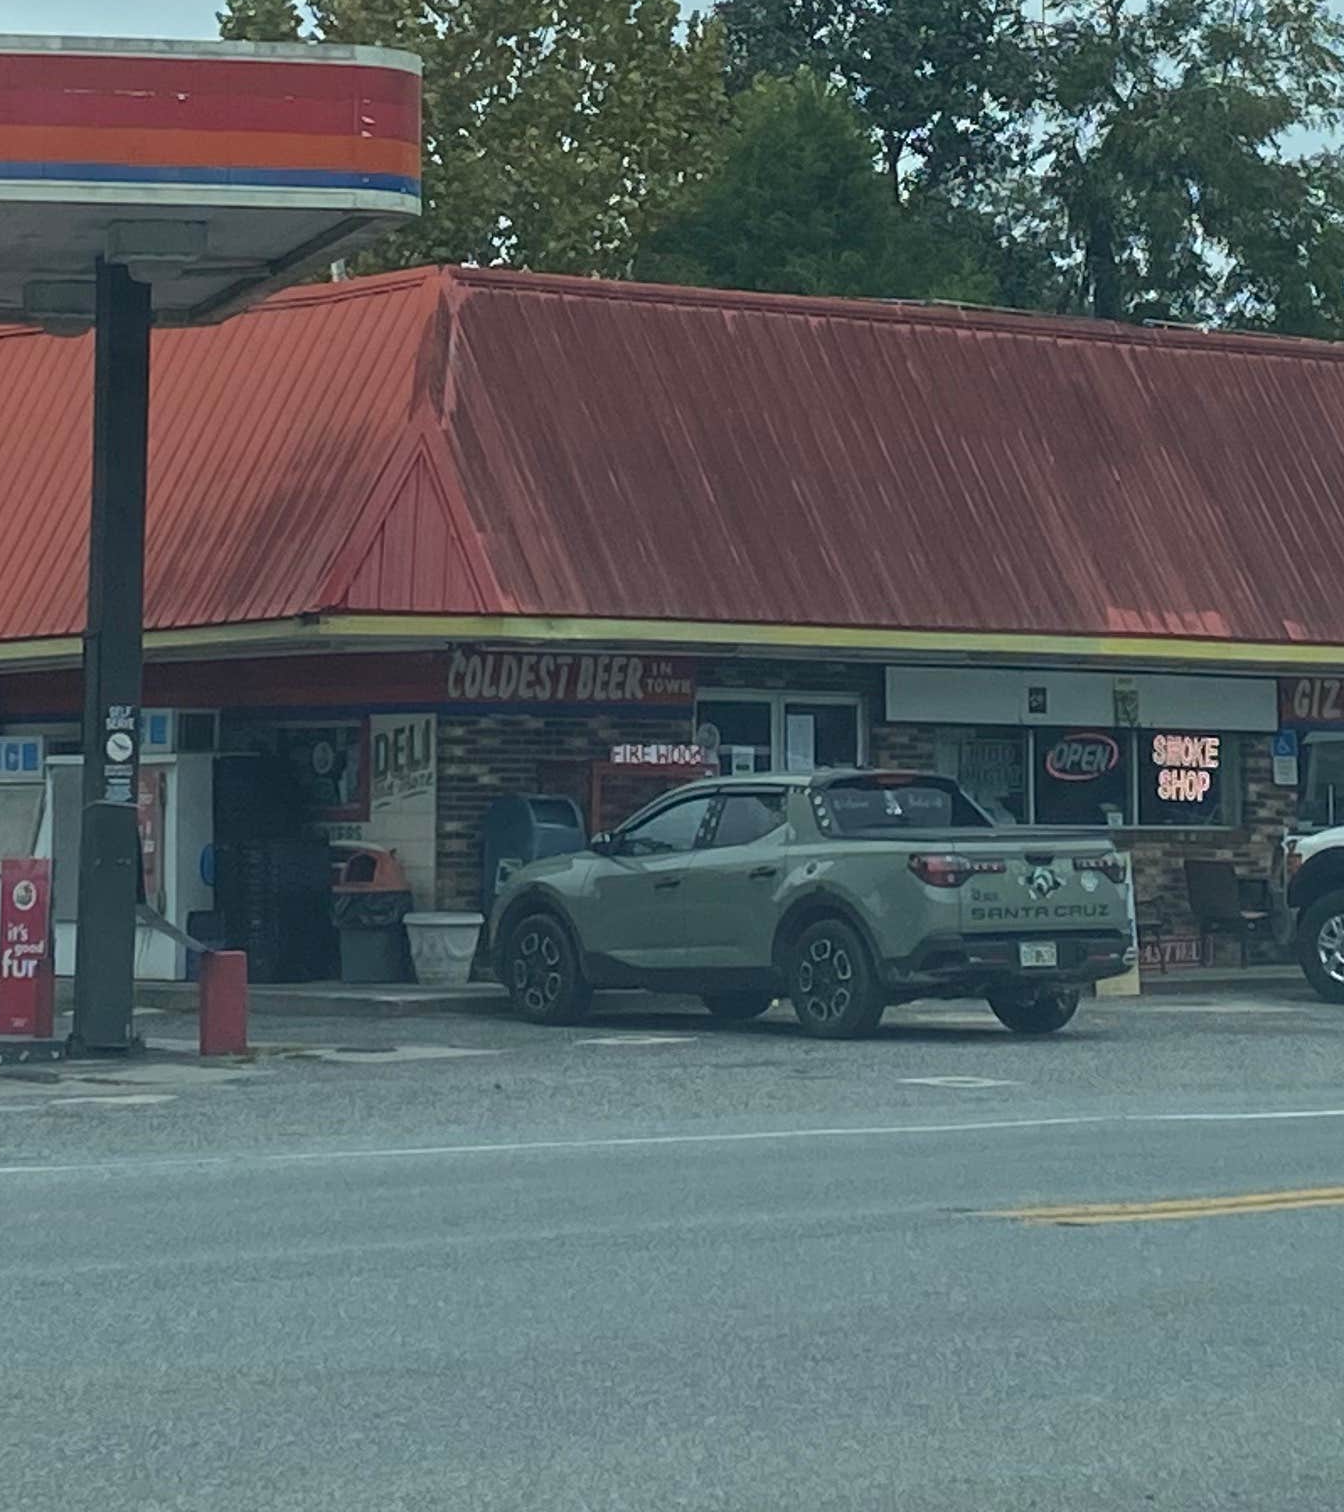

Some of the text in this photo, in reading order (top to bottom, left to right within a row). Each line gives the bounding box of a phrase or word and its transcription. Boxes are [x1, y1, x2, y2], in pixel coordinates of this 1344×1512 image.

[447, 654, 644, 701] COLDEST BEER
[374, 718, 431, 780] DELI
[1055, 741, 1109, 772] OPEN
[1152, 734, 1220, 768] SMOKE
[1157, 769, 1211, 802] SHOP
[971, 903, 1109, 921] SANTA CRUZ
[7, 924, 28, 942] it's
[14, 940, 44, 958] good
